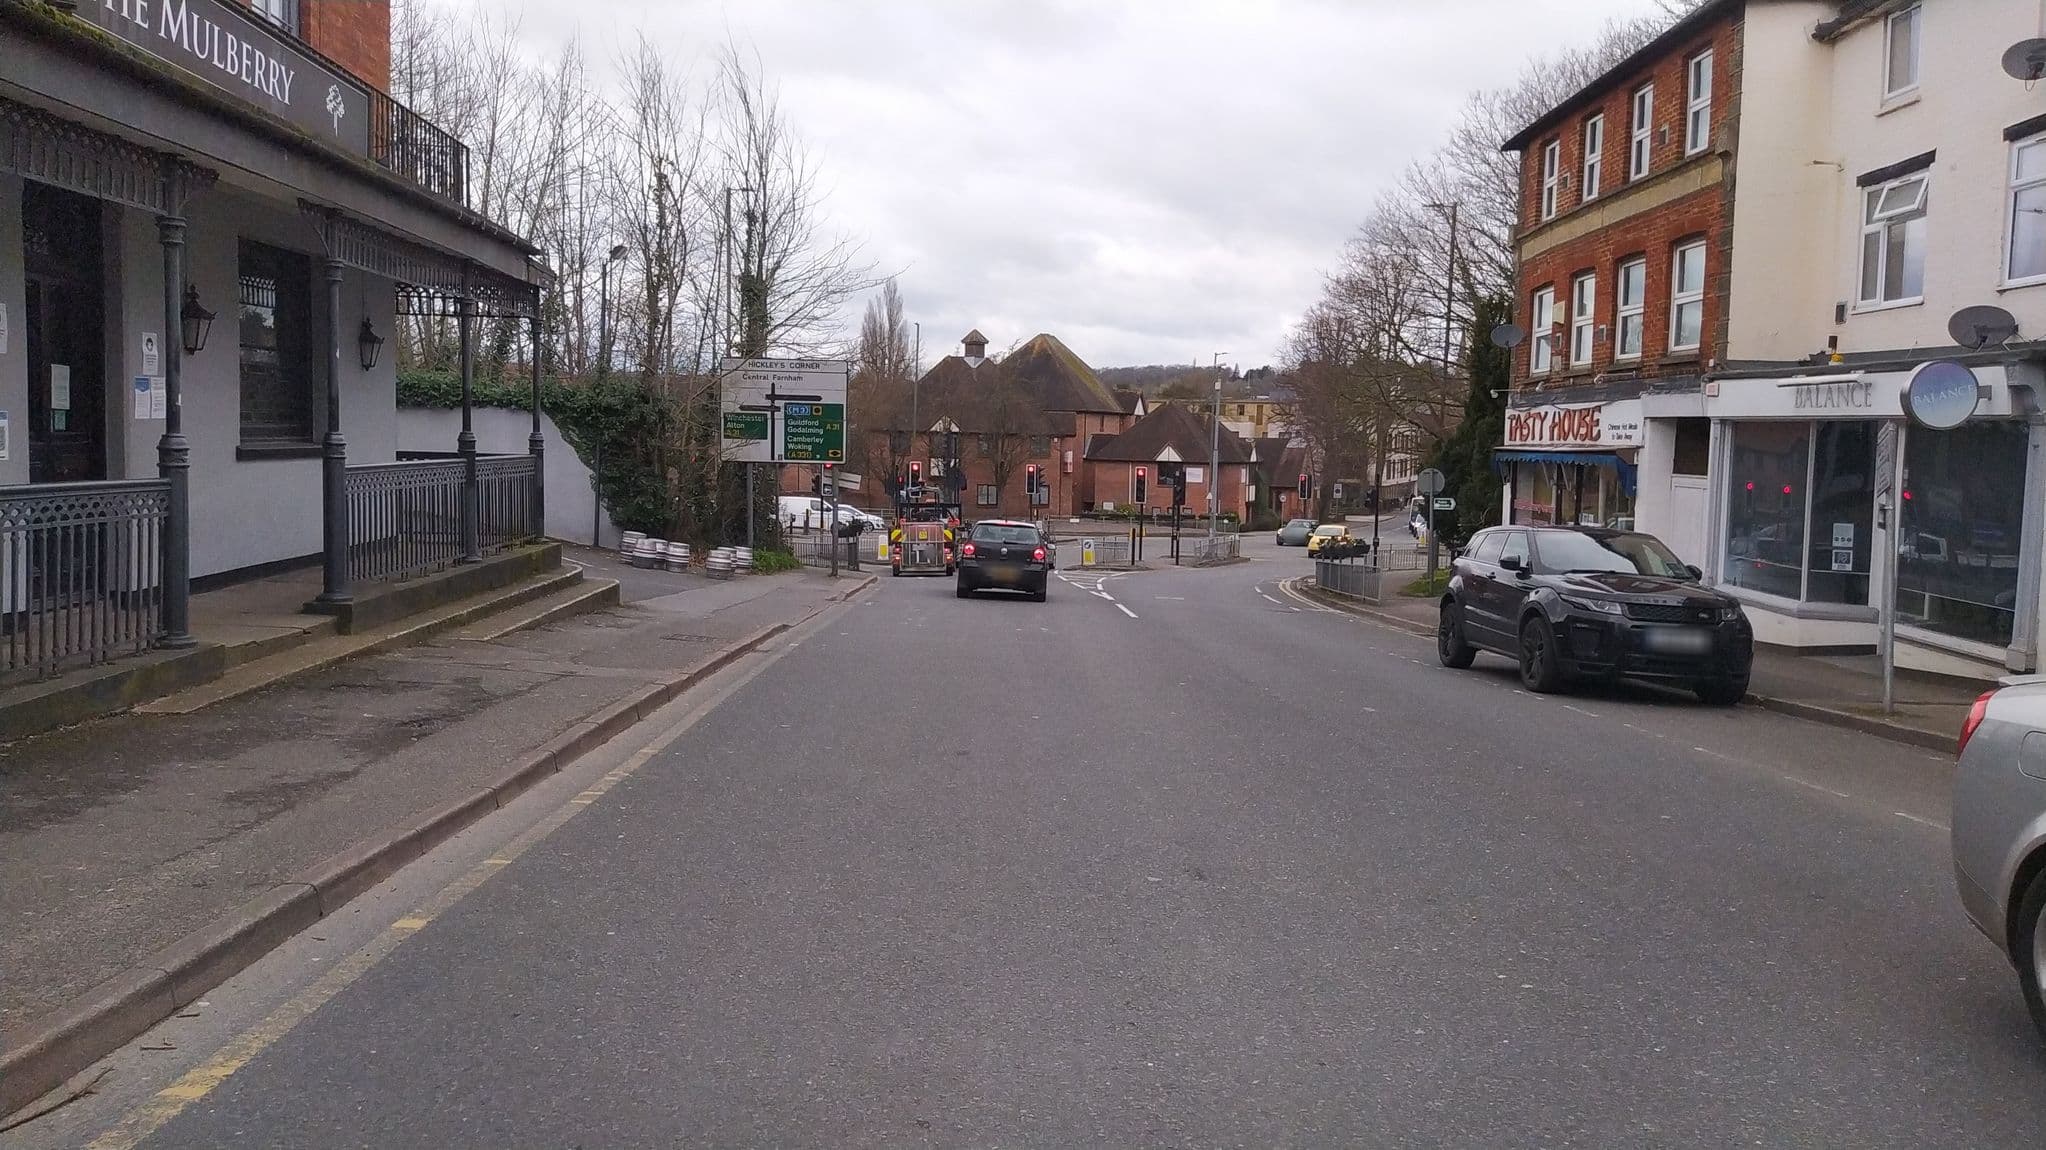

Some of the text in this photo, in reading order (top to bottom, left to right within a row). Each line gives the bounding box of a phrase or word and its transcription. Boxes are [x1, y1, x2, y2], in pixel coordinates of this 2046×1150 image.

[158, 0, 295, 105] MULBERRY
[789, 362, 820, 370] CORNER
[742, 373, 804, 382] Central Farnham
[1794, 382, 1872, 409] BALANCE
[1912, 383, 1976, 407] BALANCE
[726, 421, 745, 429] Alton
[787, 418, 819, 426] Guildford
[1507, 405, 1601, 442] TASTY HOUSE
[787, 426, 824, 435] Godalming
[787, 435, 824, 444] Camberley
[787, 443, 813, 452] Woking
